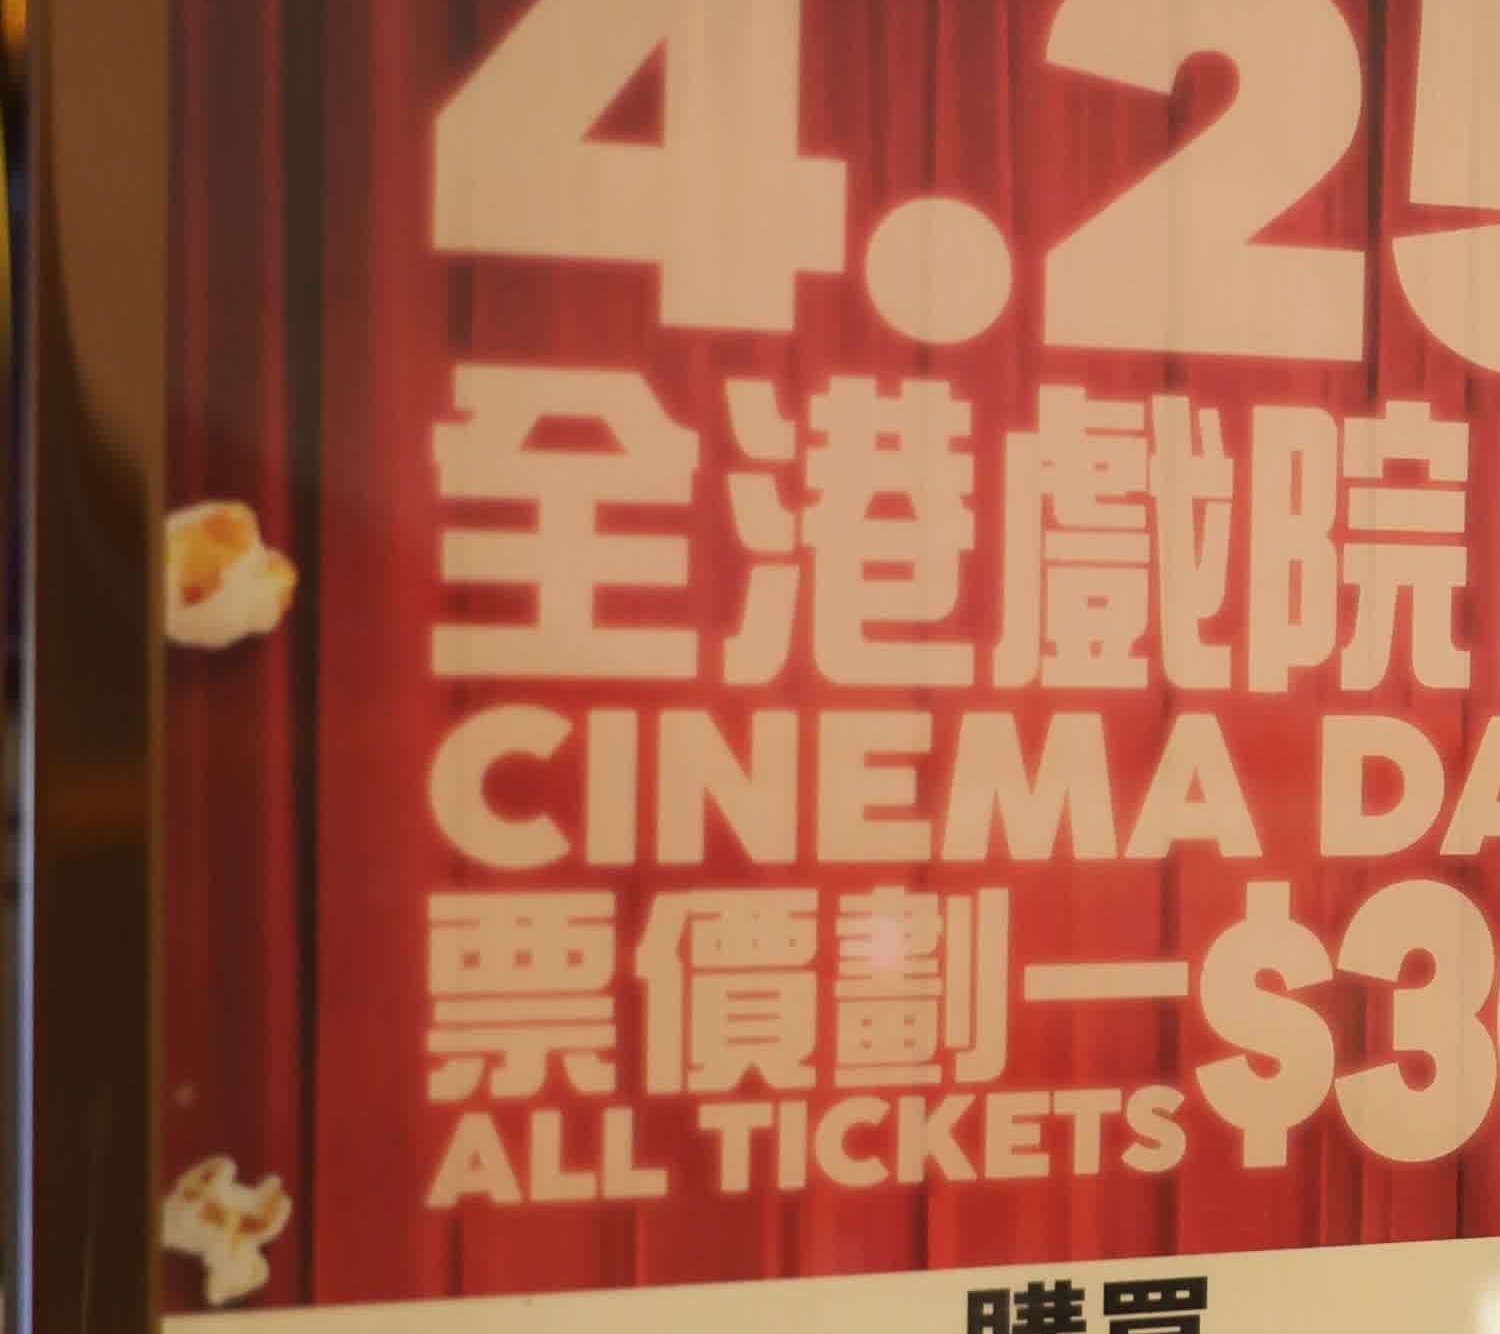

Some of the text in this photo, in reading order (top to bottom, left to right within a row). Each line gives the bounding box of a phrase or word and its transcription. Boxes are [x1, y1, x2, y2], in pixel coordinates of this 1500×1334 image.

[428, 705, 1265, 869] CINEMA
[426, 884, 1191, 1101] 票價劃一
[428, 1083, 1188, 1207] ALL TICKETS
